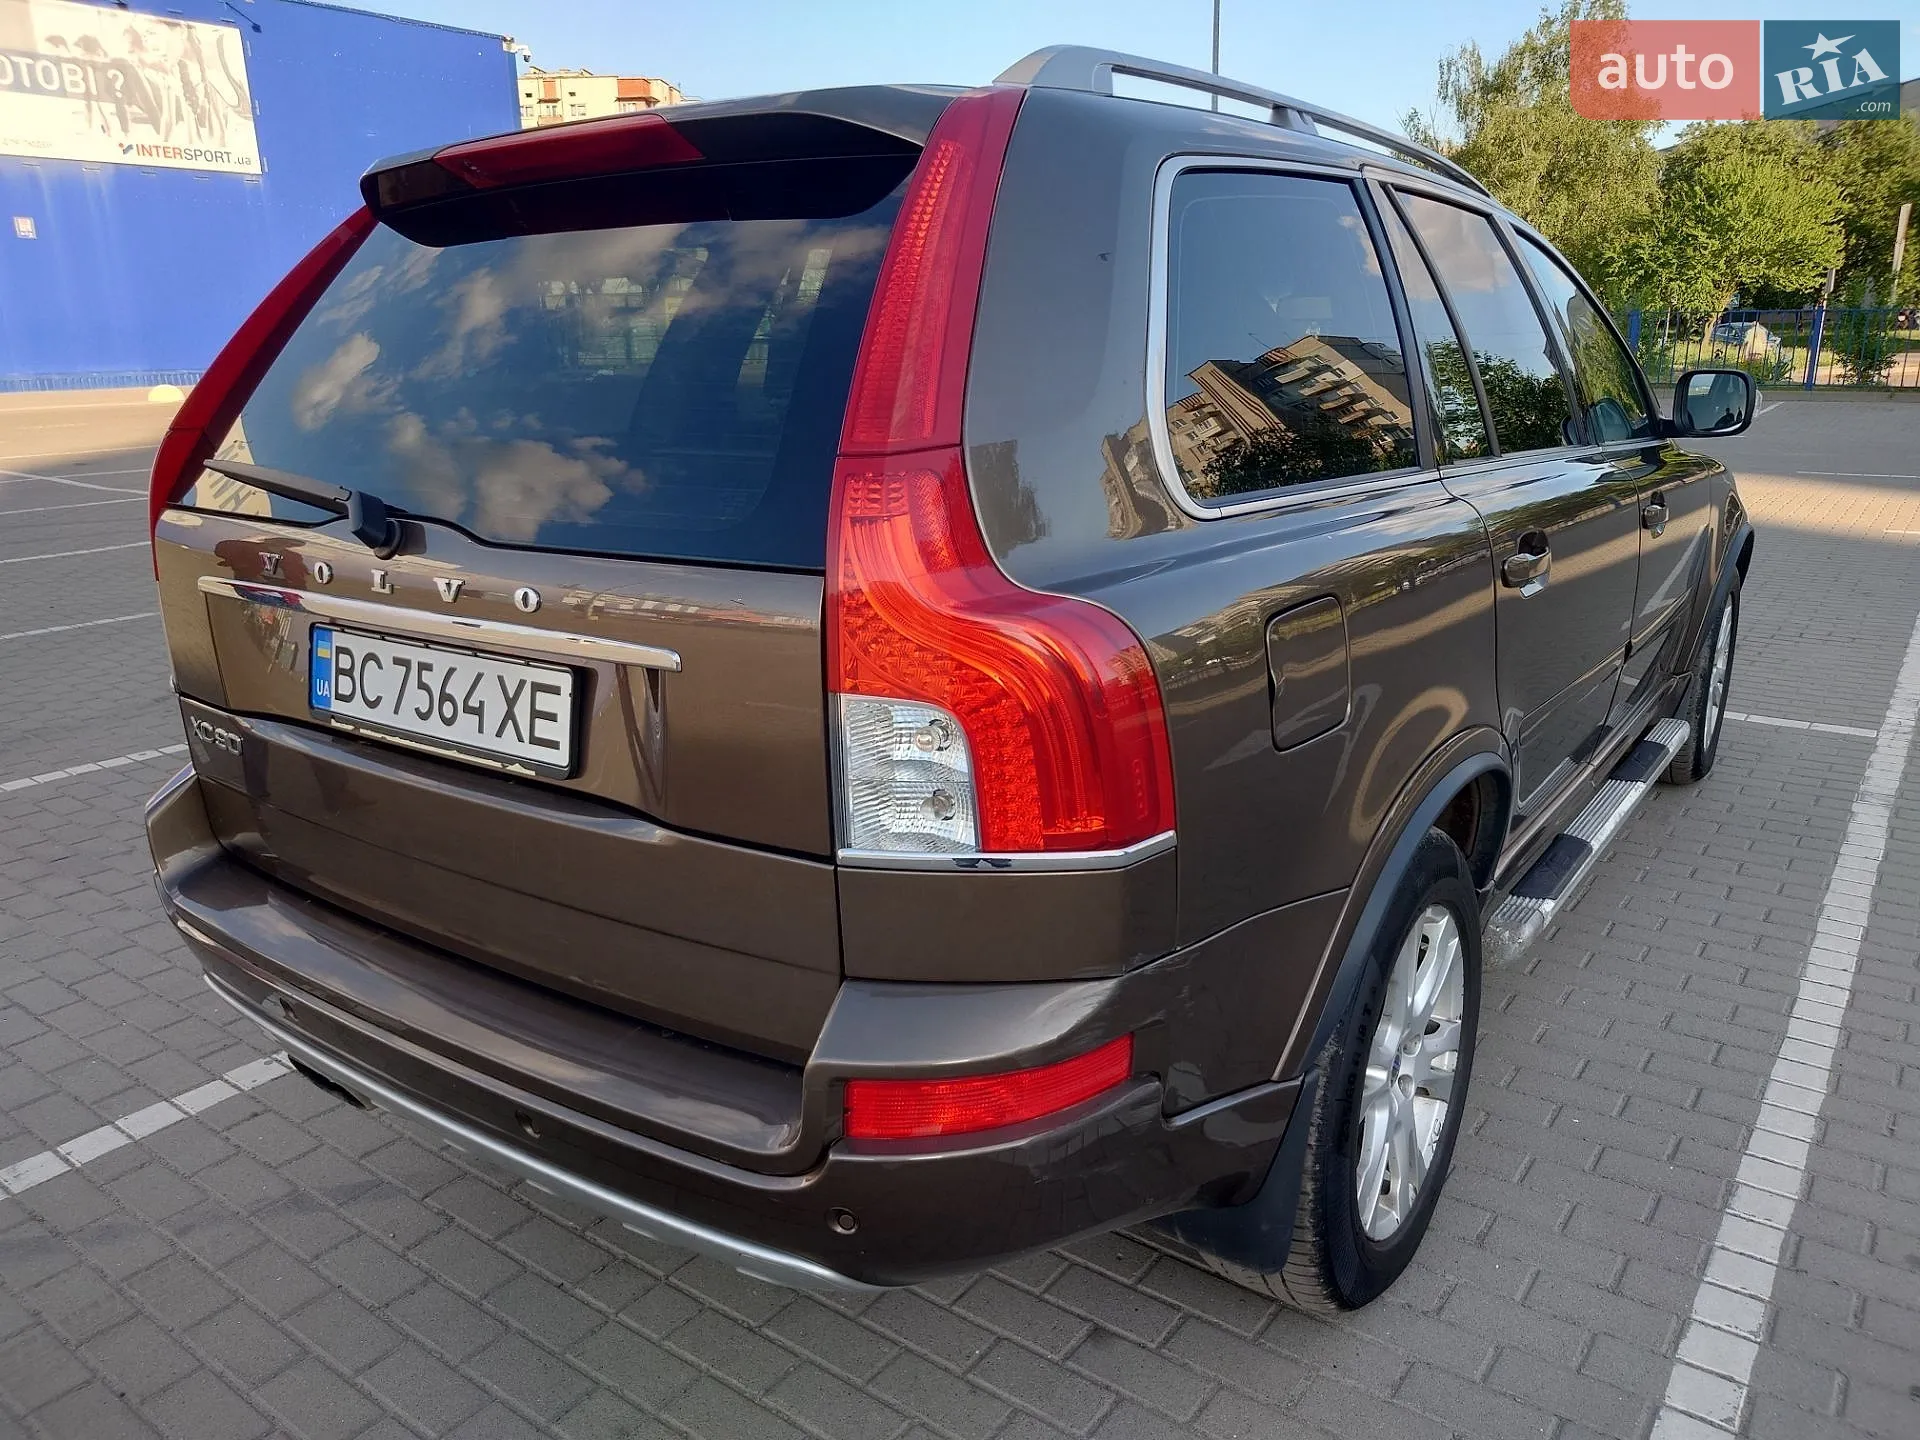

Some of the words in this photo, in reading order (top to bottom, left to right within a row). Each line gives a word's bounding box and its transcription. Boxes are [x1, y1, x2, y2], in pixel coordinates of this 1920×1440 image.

[258, 551, 542, 613] VOLVO
[317, 678, 330, 698] UA
[190, 715, 243, 757] XC90
